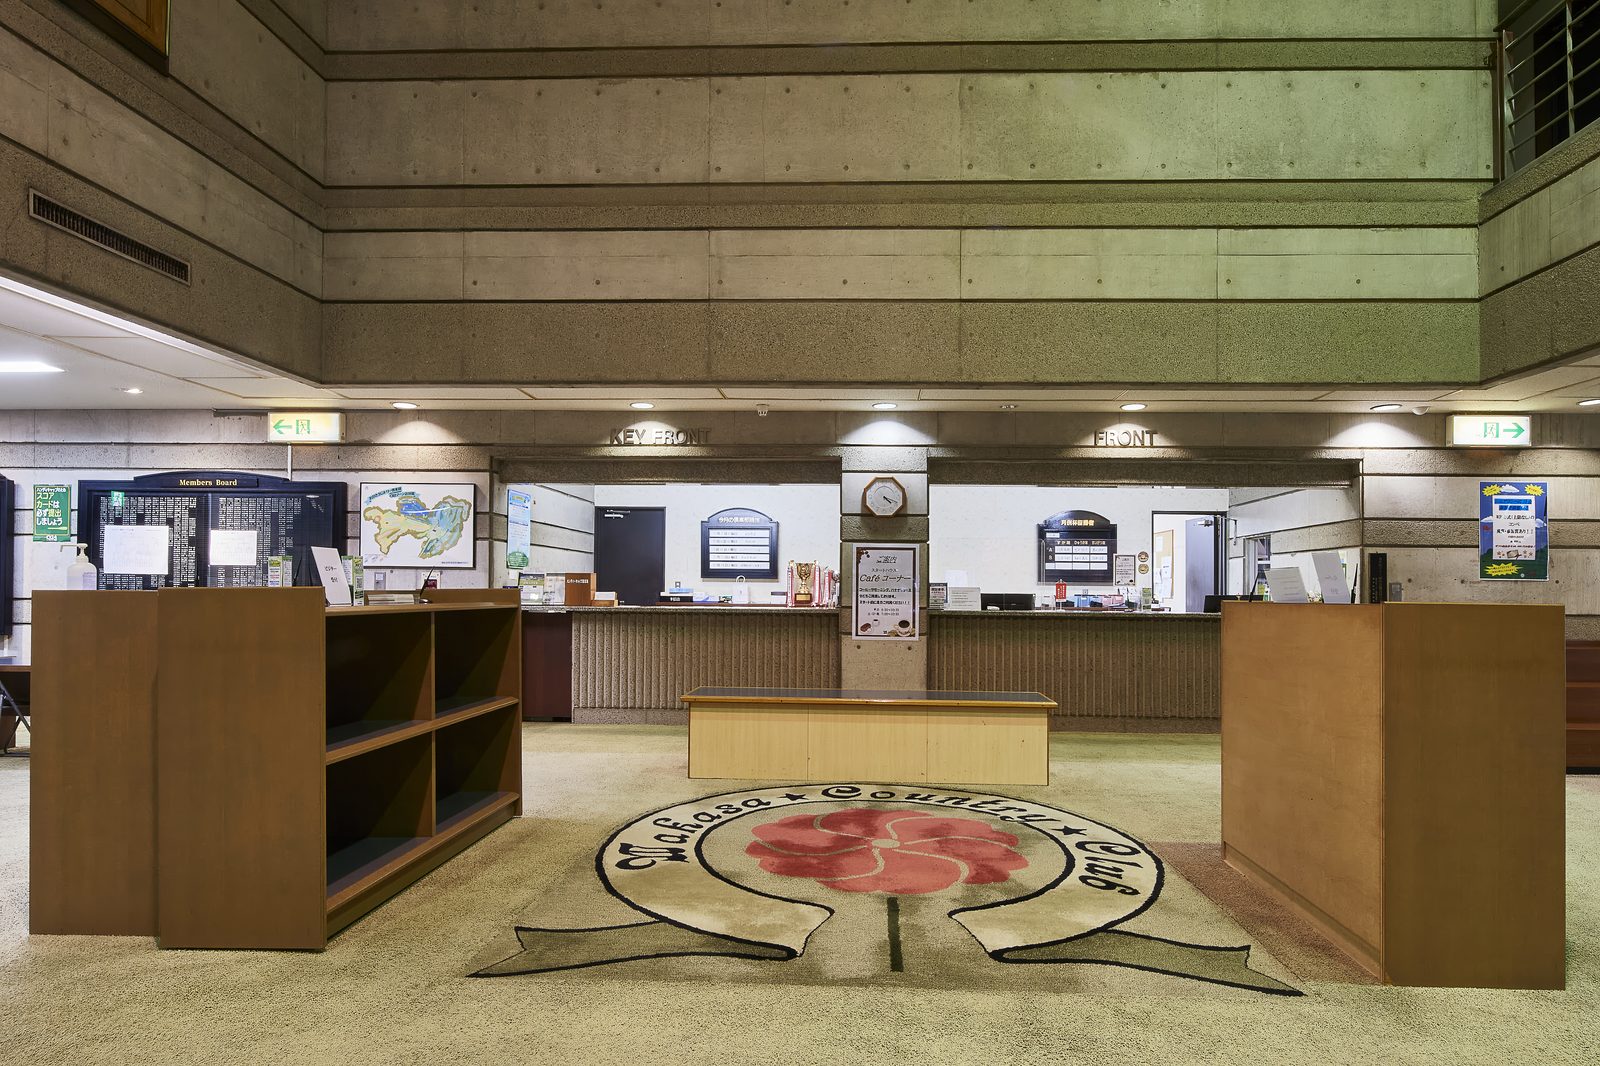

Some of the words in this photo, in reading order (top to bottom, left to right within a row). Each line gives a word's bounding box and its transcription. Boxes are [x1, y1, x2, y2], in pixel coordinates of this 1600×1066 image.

[609, 428, 646, 445] KEY
[653, 428, 712, 445] FRONT
[1094, 430, 1158, 446] FRONT
[36, 492, 55, 500] スコア
[36, 500, 60, 509] カードは
[36, 509, 62, 518] 必ず提出
[36, 517, 63, 526] しましょう
[859, 574, 881, 582] Café
[881, 574, 912, 583] コーナー
[615, 798, 772, 870] Wakasa
[821, 785, 1062, 823] Country
[1075, 840, 1144, 896] Club
